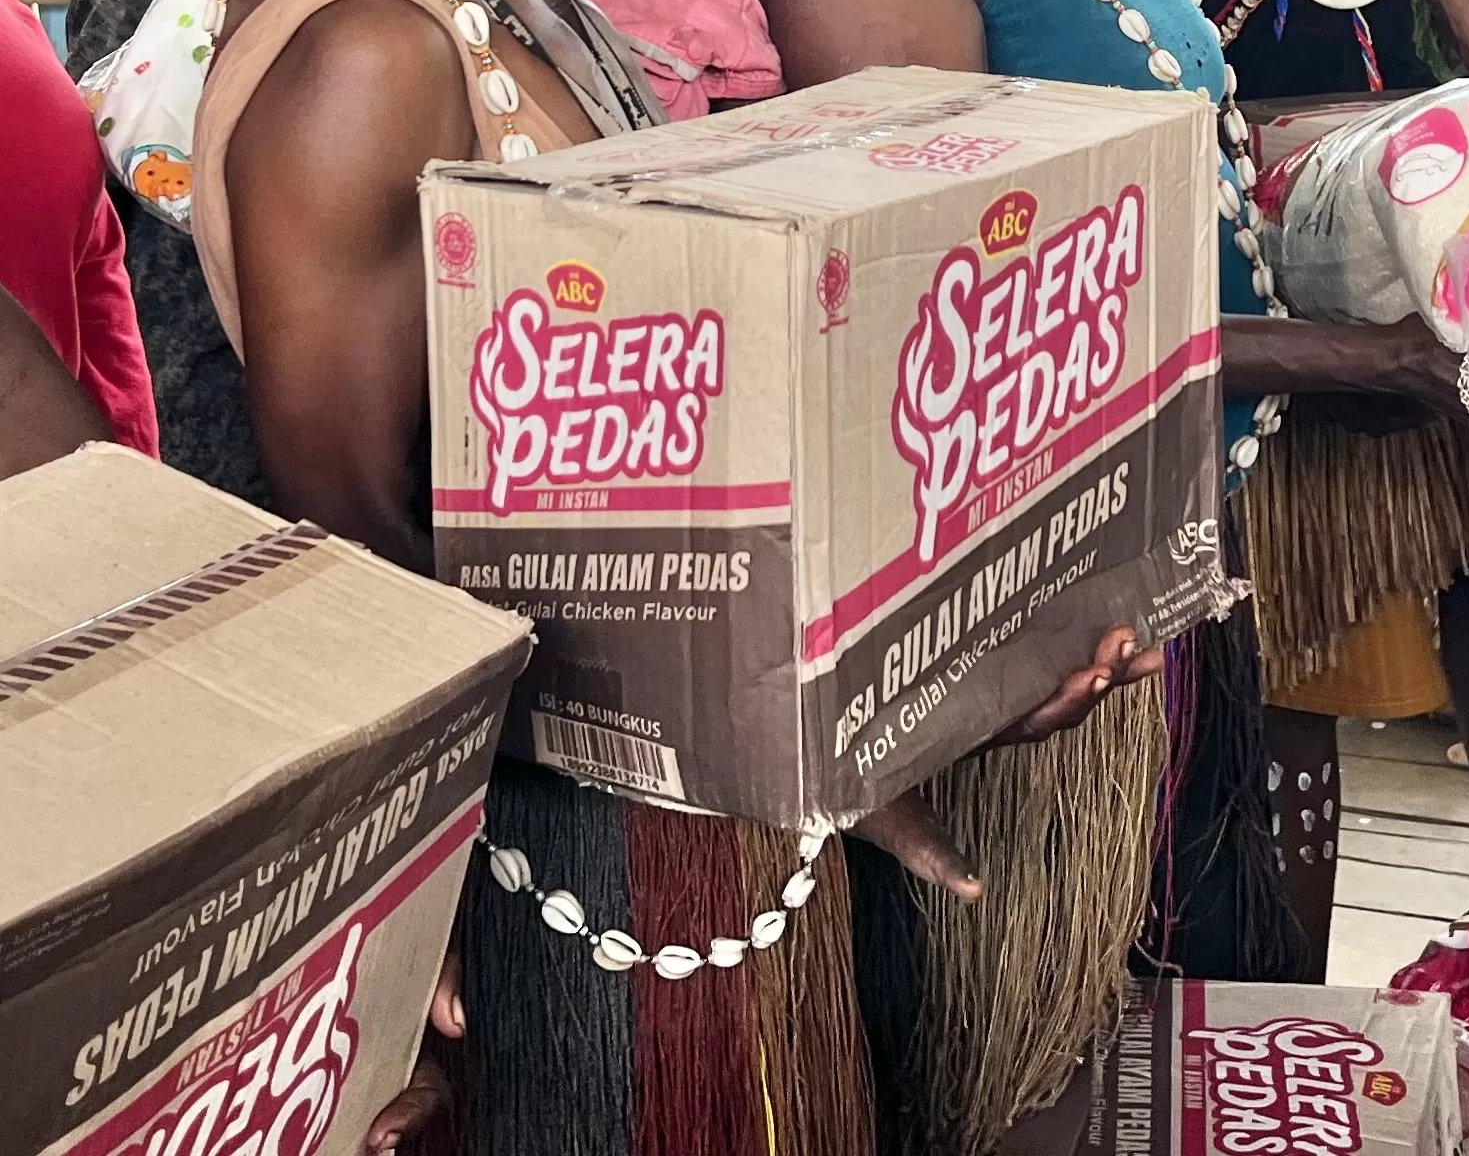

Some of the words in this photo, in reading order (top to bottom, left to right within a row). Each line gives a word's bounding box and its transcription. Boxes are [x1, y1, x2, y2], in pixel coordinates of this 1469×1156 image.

[986, 207, 1029, 245] ABC
[556, 279, 596, 306] ABC
[918, 195, 1139, 423] SELERA
[493, 297, 720, 410] SELERA
[490, 393, 700, 510] PEDAS
[917, 294, 1123, 562] PEDAS
[536, 491, 554, 510] MI
[559, 490, 609, 510] INSTAN
[966, 496, 988, 535] MI
[995, 448, 1054, 514] INSTAN
[460, 565, 501, 589] RASA
[507, 552, 578, 592] GULAI
[580, 552, 654, 592] AYAM
[659, 551, 751, 592] PEDAS
[562, 601, 636, 621] Chicken
[642, 602, 717, 622] Flavour
[882, 587, 963, 705] GULAI
[966, 526, 1042, 633] AYAM
[1045, 461, 1129, 569] PEDAS
[855, 724, 898, 777] Hot
[900, 675, 949, 734] Gulai
[1027, 548, 1098, 620] Flavour
[436, 711, 496, 784] RASA
[440, 697, 488, 745] Hot
[566, 700, 585, 717] 40
[587, 704, 662, 739] BUNGKUS
[324, 766, 429, 901] GULAI
[129, 877, 245, 985] Flavour
[213, 851, 328, 993] AYAM
[65, 944, 214, 1107] PEDAS
[273, 964, 306, 1014] MI
[1117, 1057, 1152, 1104] AYAM
[1188, 1029, 1288, 1154] PEDAS
[1369, 1073, 1394, 1100] ABC
[1116, 1107, 1151, 1156] PEDA
